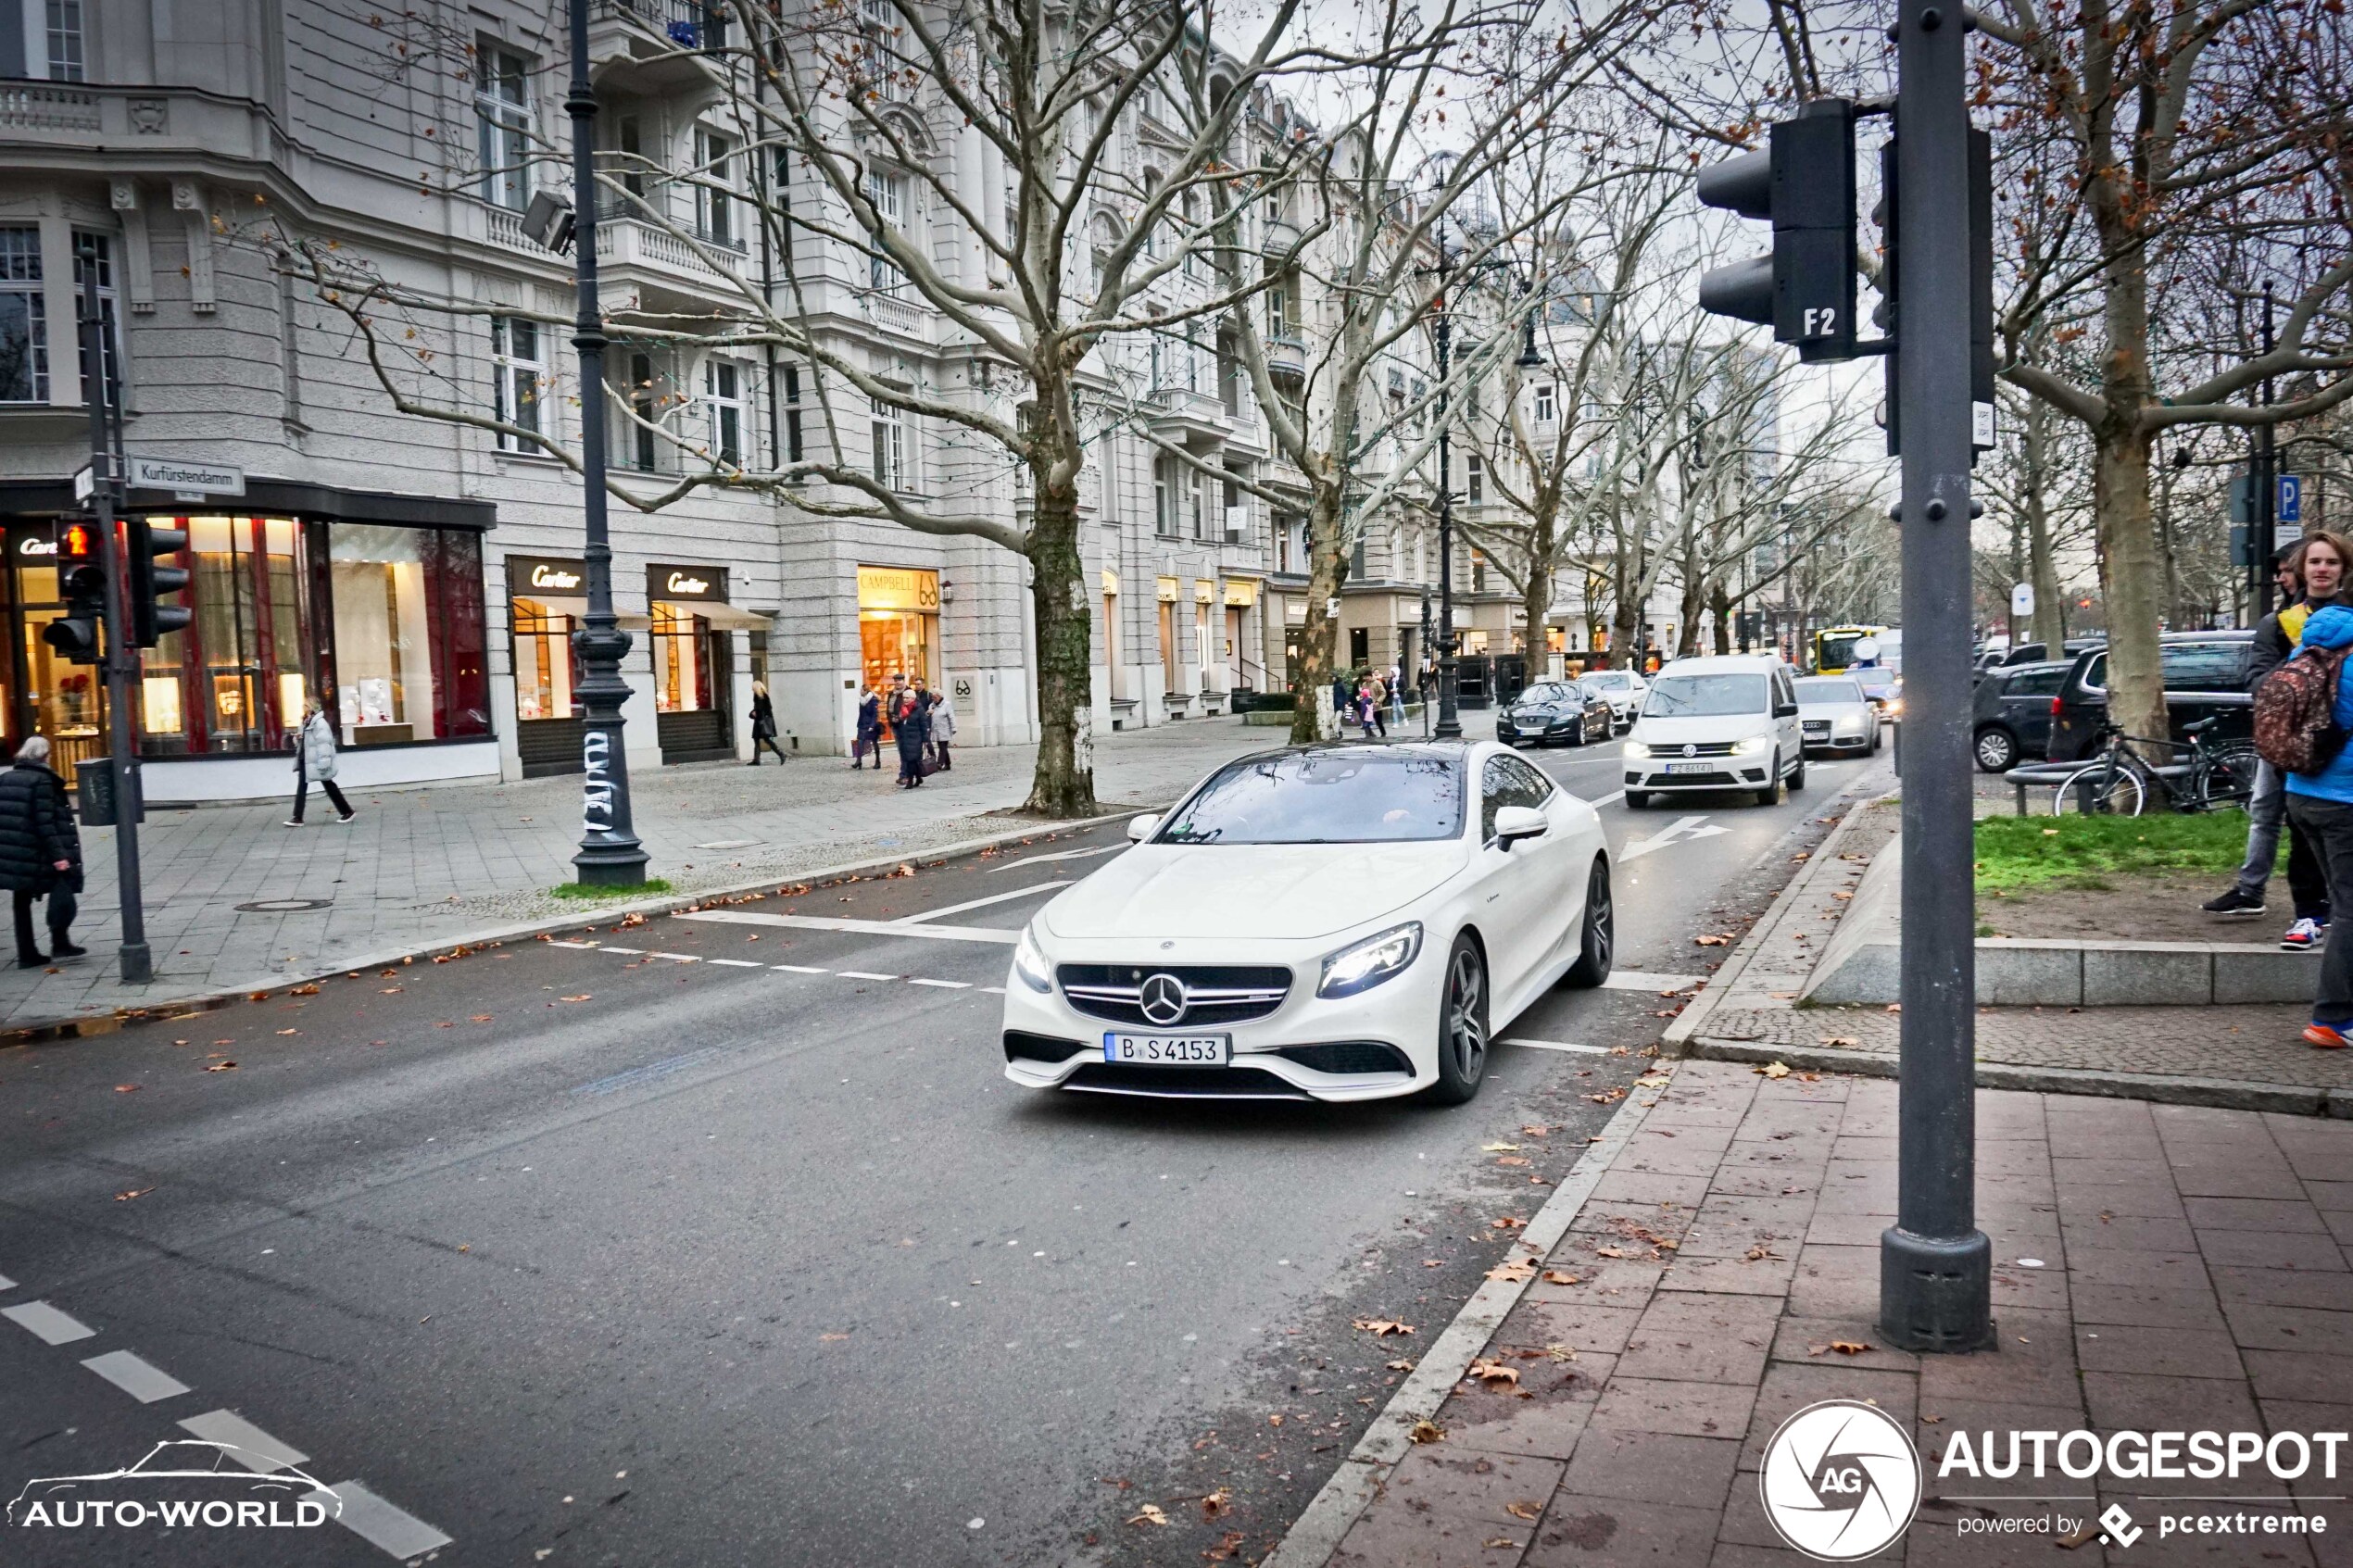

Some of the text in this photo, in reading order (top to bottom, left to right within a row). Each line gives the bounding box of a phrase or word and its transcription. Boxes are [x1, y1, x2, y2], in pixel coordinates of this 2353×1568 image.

[1805, 307, 1835, 335] F2
[141, 464, 233, 486] Kurfürstendamm
[19, 538, 58, 555] Cart
[532, 565, 581, 588] Cartier
[668, 572, 709, 593] Cartier
[861, 574, 912, 591] CAMPBELL
[1123, 1038, 1134, 1058] B
